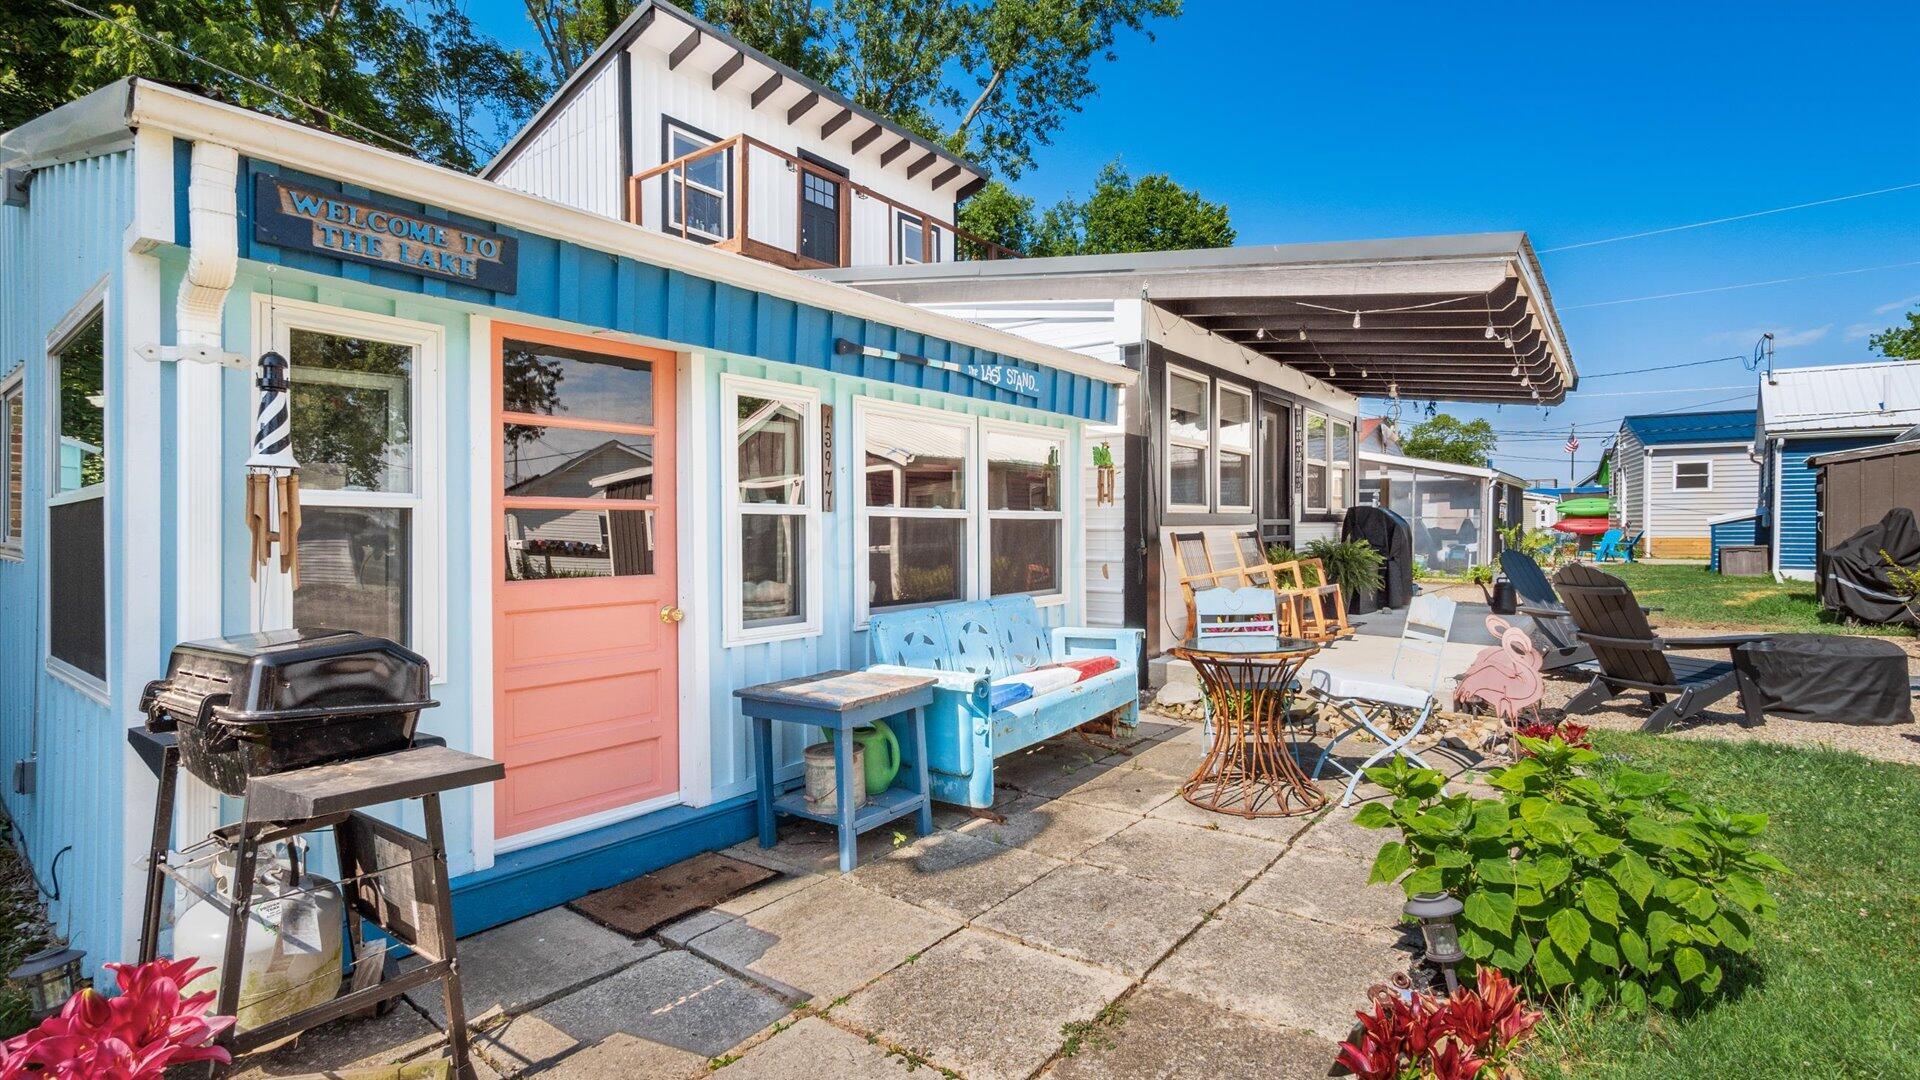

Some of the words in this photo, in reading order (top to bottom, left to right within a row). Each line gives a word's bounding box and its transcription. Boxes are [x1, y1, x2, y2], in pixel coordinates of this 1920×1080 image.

[288, 189, 450, 249] WELCOME
[460, 230, 498, 259] TO
[316, 221, 384, 258] THE
[399, 239, 478, 280] LAKE
[980, 364, 1002, 385] LAST
[824, 414, 833, 509] 13977
